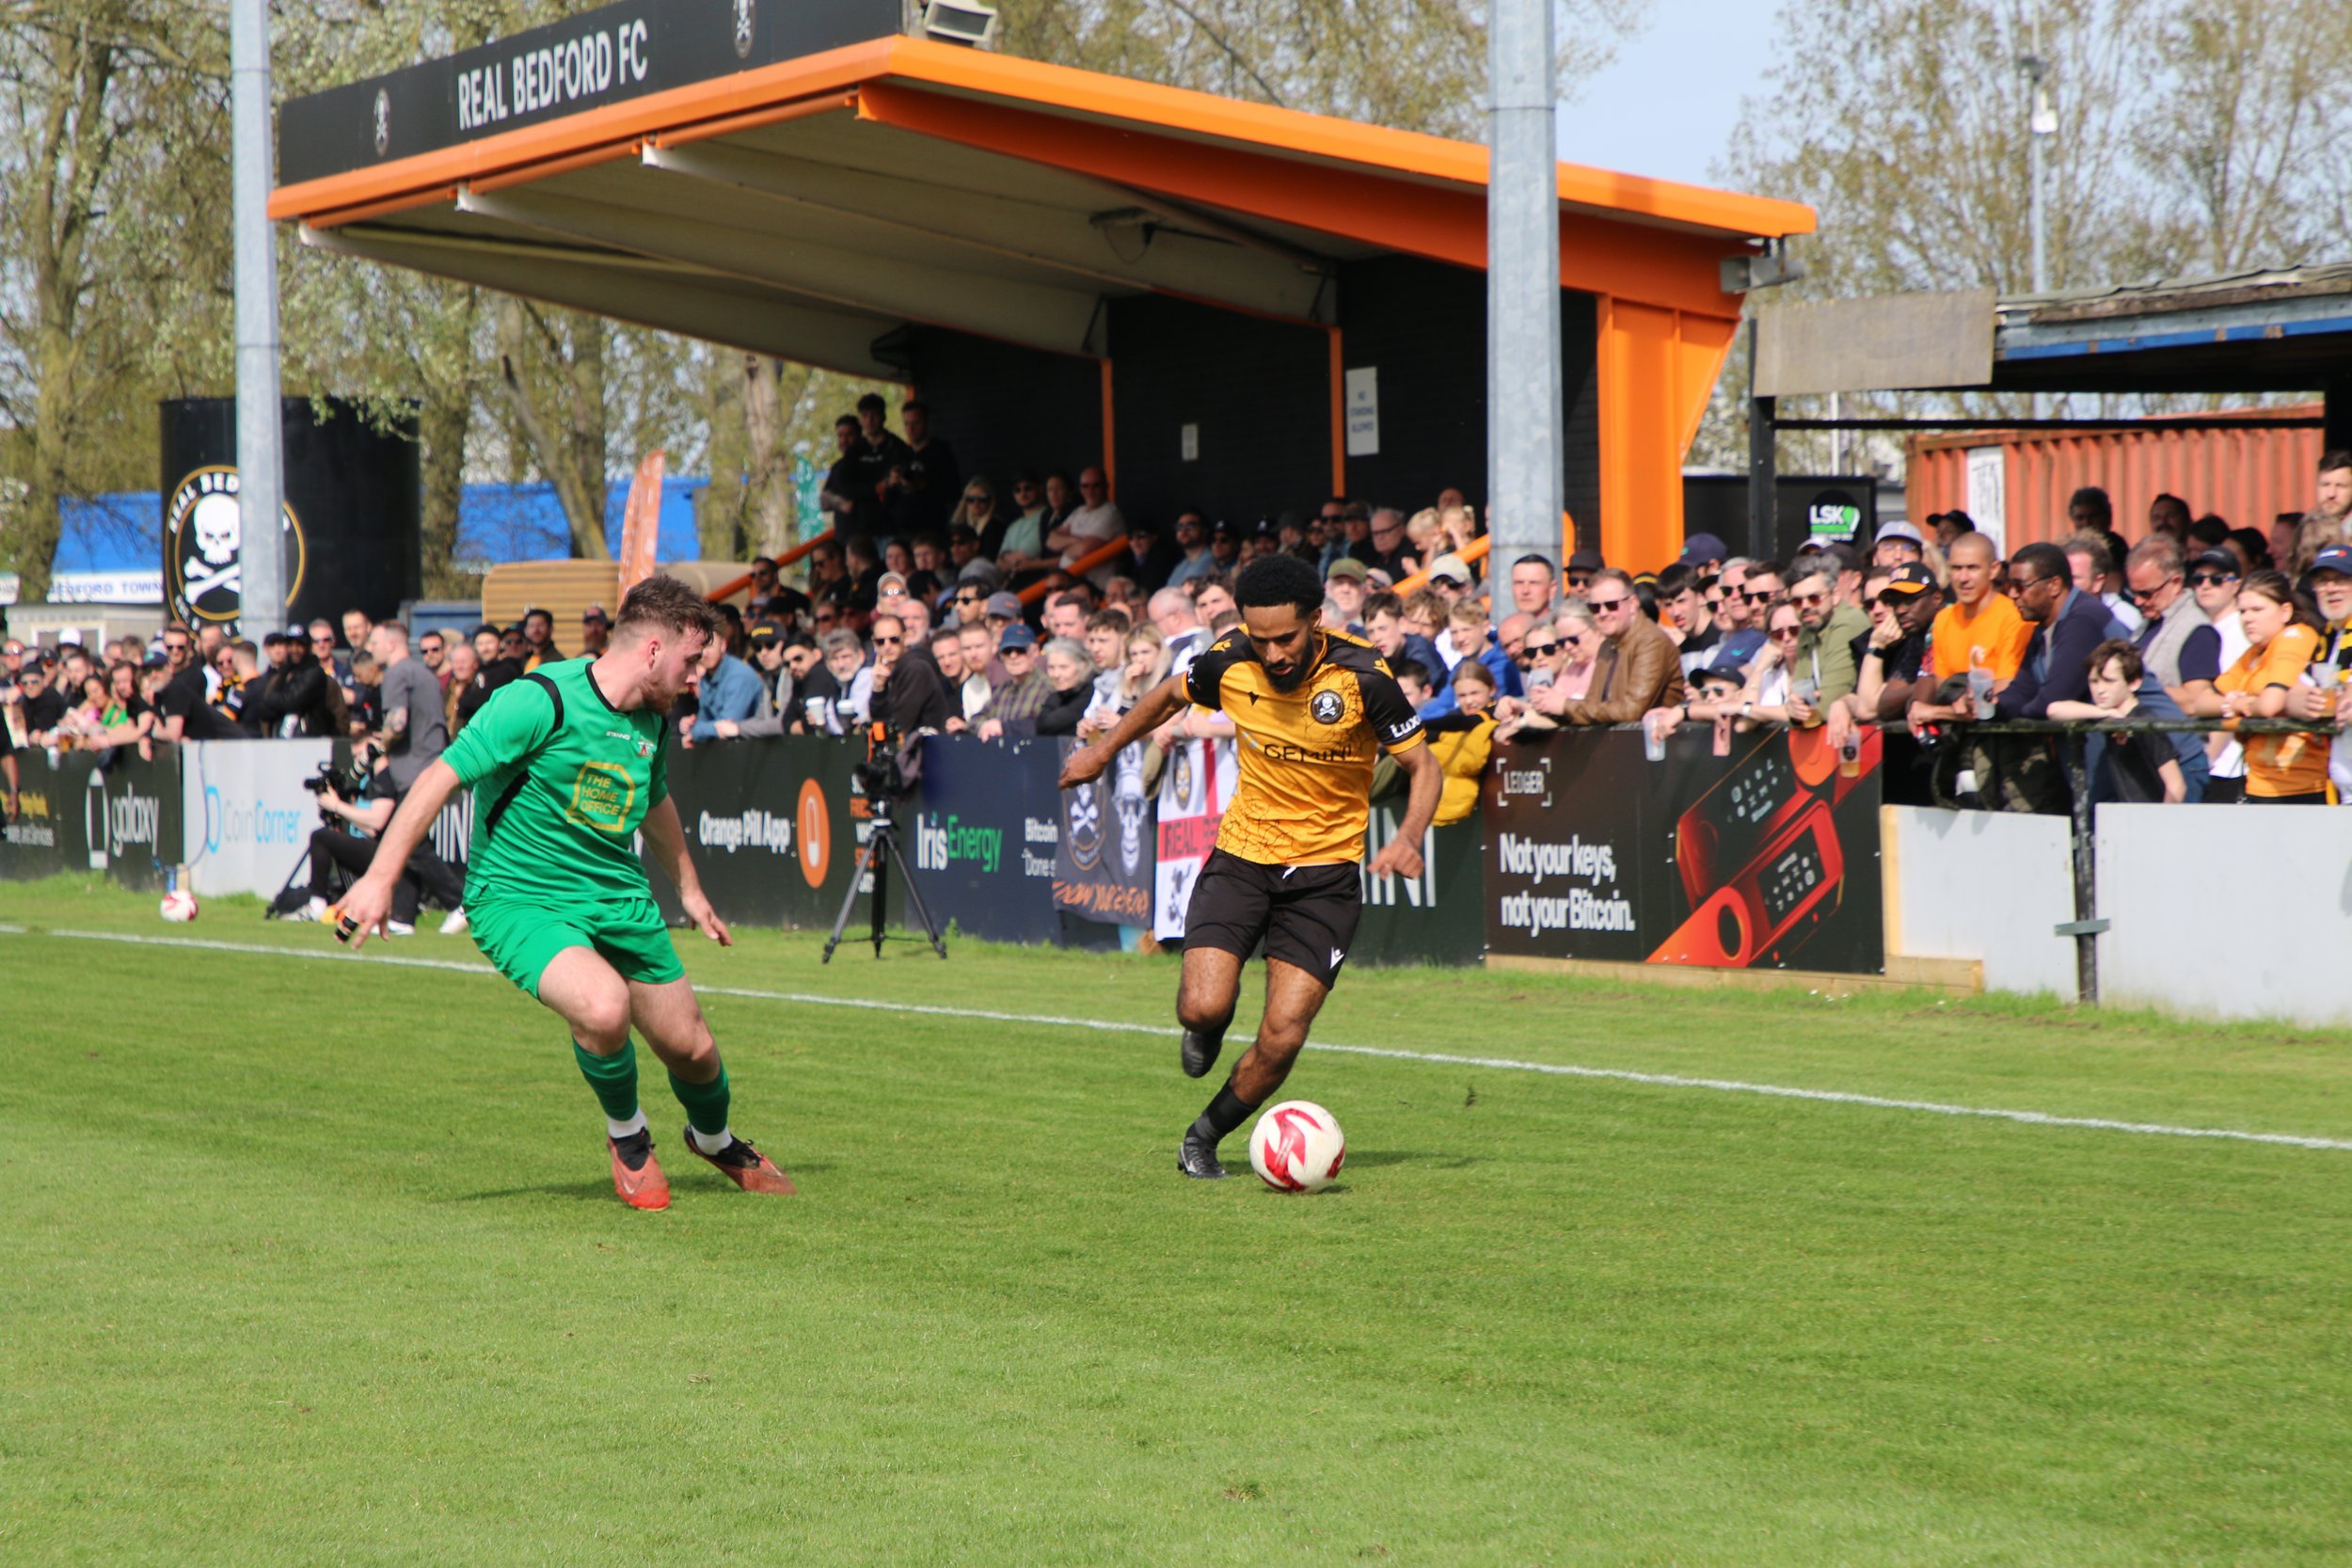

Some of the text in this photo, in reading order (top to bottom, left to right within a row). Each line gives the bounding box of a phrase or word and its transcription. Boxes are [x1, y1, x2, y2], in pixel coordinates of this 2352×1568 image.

[458, 18, 648, 131] REAL BEDFORD FC
[581, 785, 619, 802] HOME
[586, 773, 612, 789] THE
[1503, 770, 1545, 795] LEDGER
[112, 781, 159, 858] galaxy
[580, 800, 621, 816] OFFICE
[699, 808, 791, 854] Orange Pill App
[1500, 832, 1617, 886] Not your keys,
[1501, 887, 1635, 938] not your Bitcoin.
